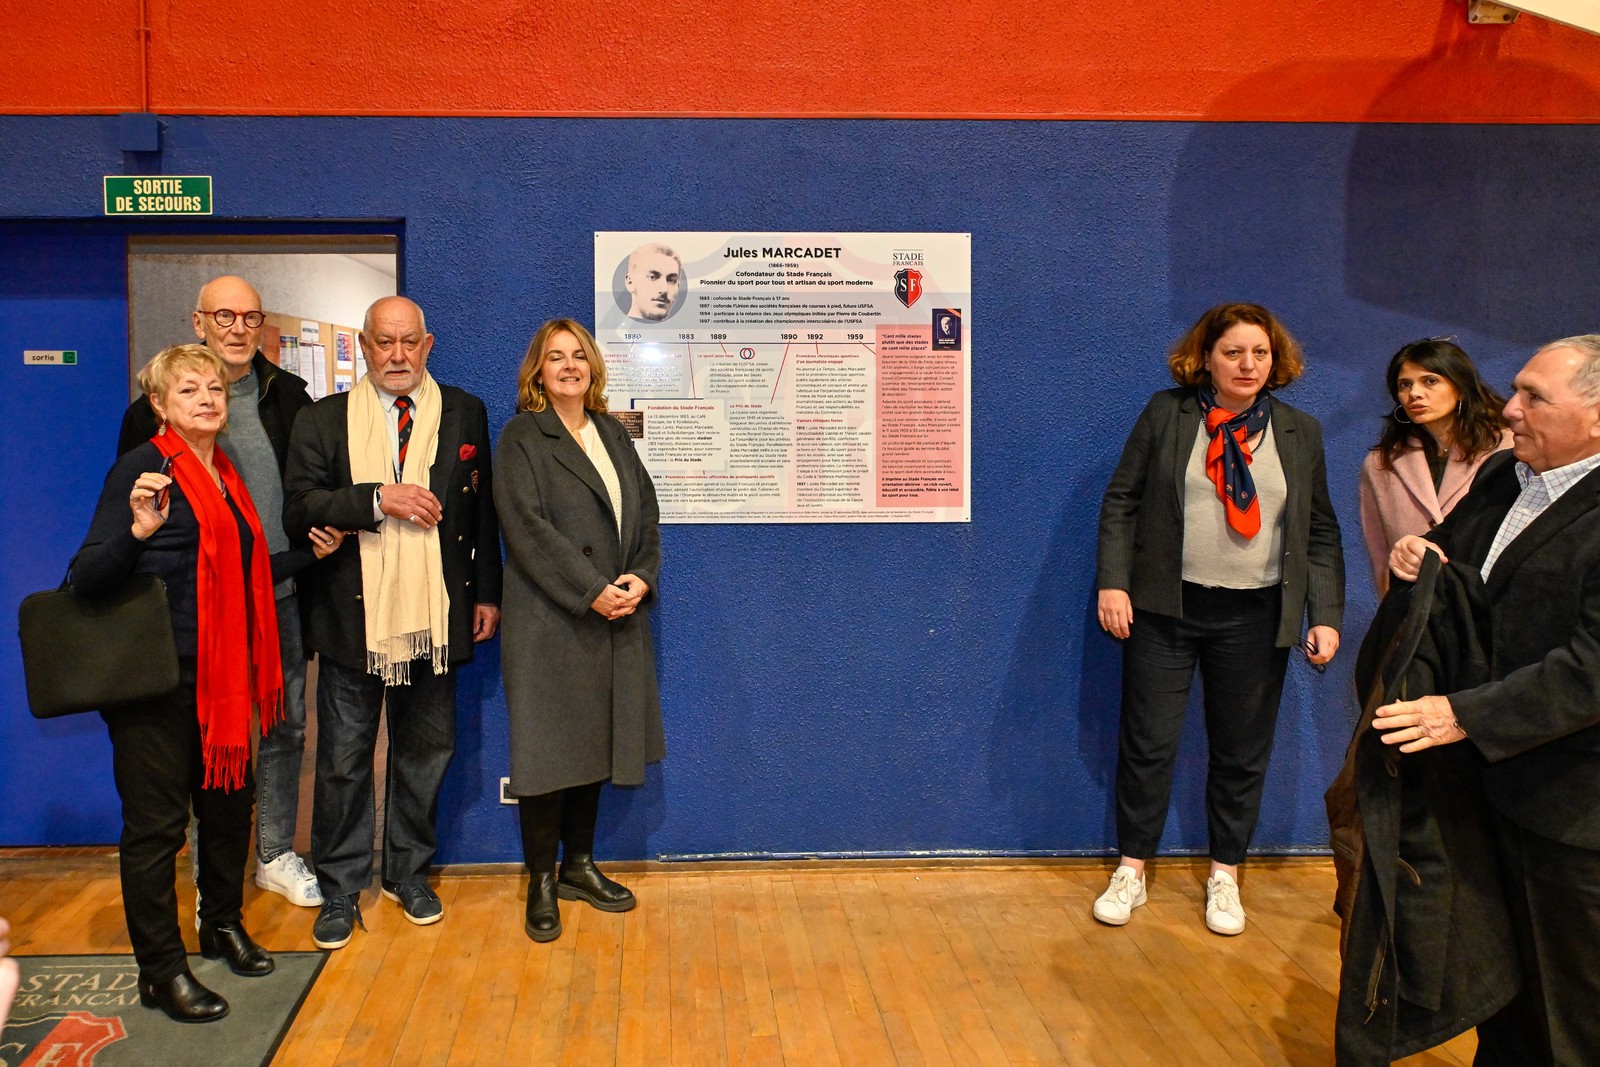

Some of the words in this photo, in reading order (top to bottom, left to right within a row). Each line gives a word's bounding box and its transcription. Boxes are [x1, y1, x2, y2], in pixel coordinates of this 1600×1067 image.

[133, 179, 183, 194] SORTIE
[116, 197, 133, 211] DE
[138, 196, 201, 211] SECOURS
[724, 247, 758, 258] Jules
[762, 247, 841, 258] MARCADET
[18, 973, 138, 992] STAD
